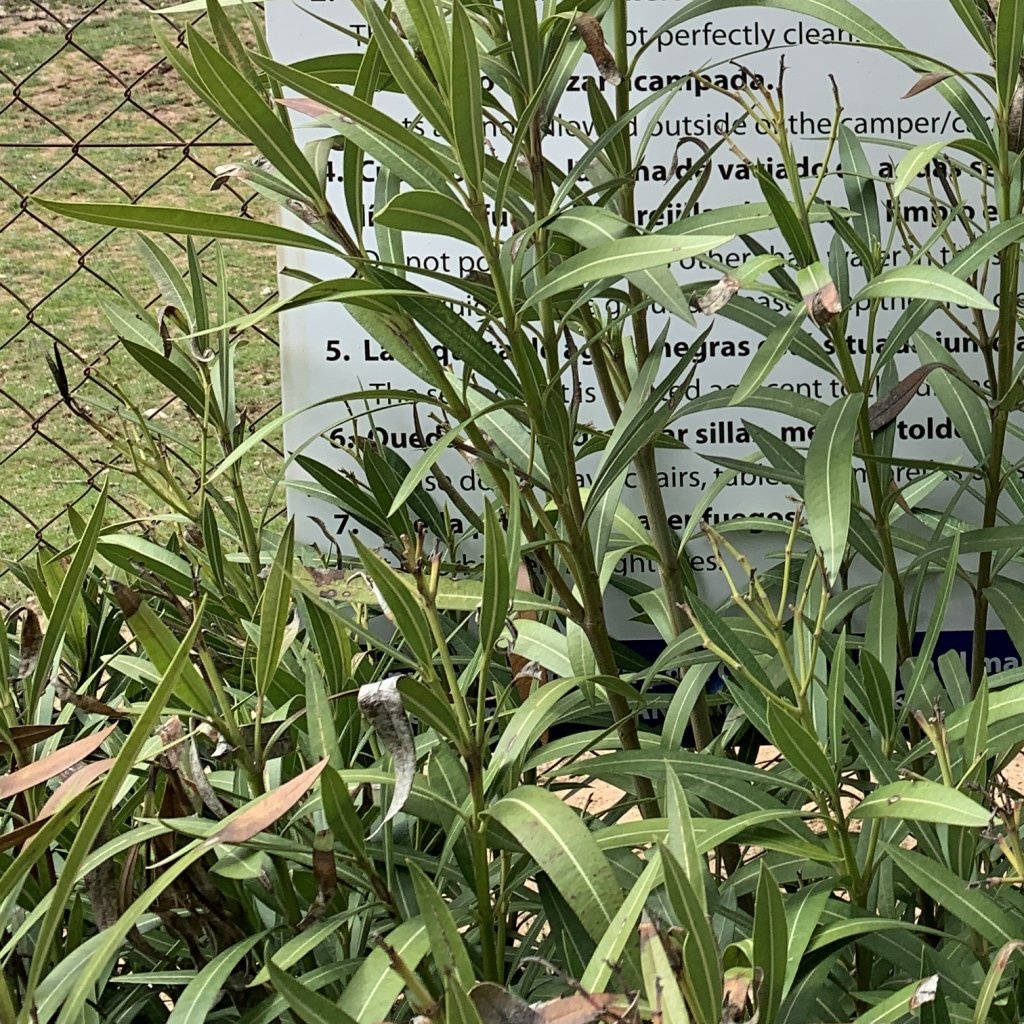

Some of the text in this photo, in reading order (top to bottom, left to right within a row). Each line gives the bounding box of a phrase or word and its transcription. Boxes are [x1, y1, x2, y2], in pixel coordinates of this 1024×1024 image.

[657, 21, 772, 53] perfectly
[628, 68, 774, 97] campada.
[651, 112, 747, 137] outside
[788, 111, 831, 135] the
[717, 156, 828, 181] vaiado
[407, 251, 450, 273] not
[326, 339, 351, 362] 5.
[330, 427, 354, 449] 6.
[368, 426, 454, 449] Qued
[897, 416, 962, 440] told
[624, 466, 707, 491] cairs,
[334, 514, 360, 535] 7.
